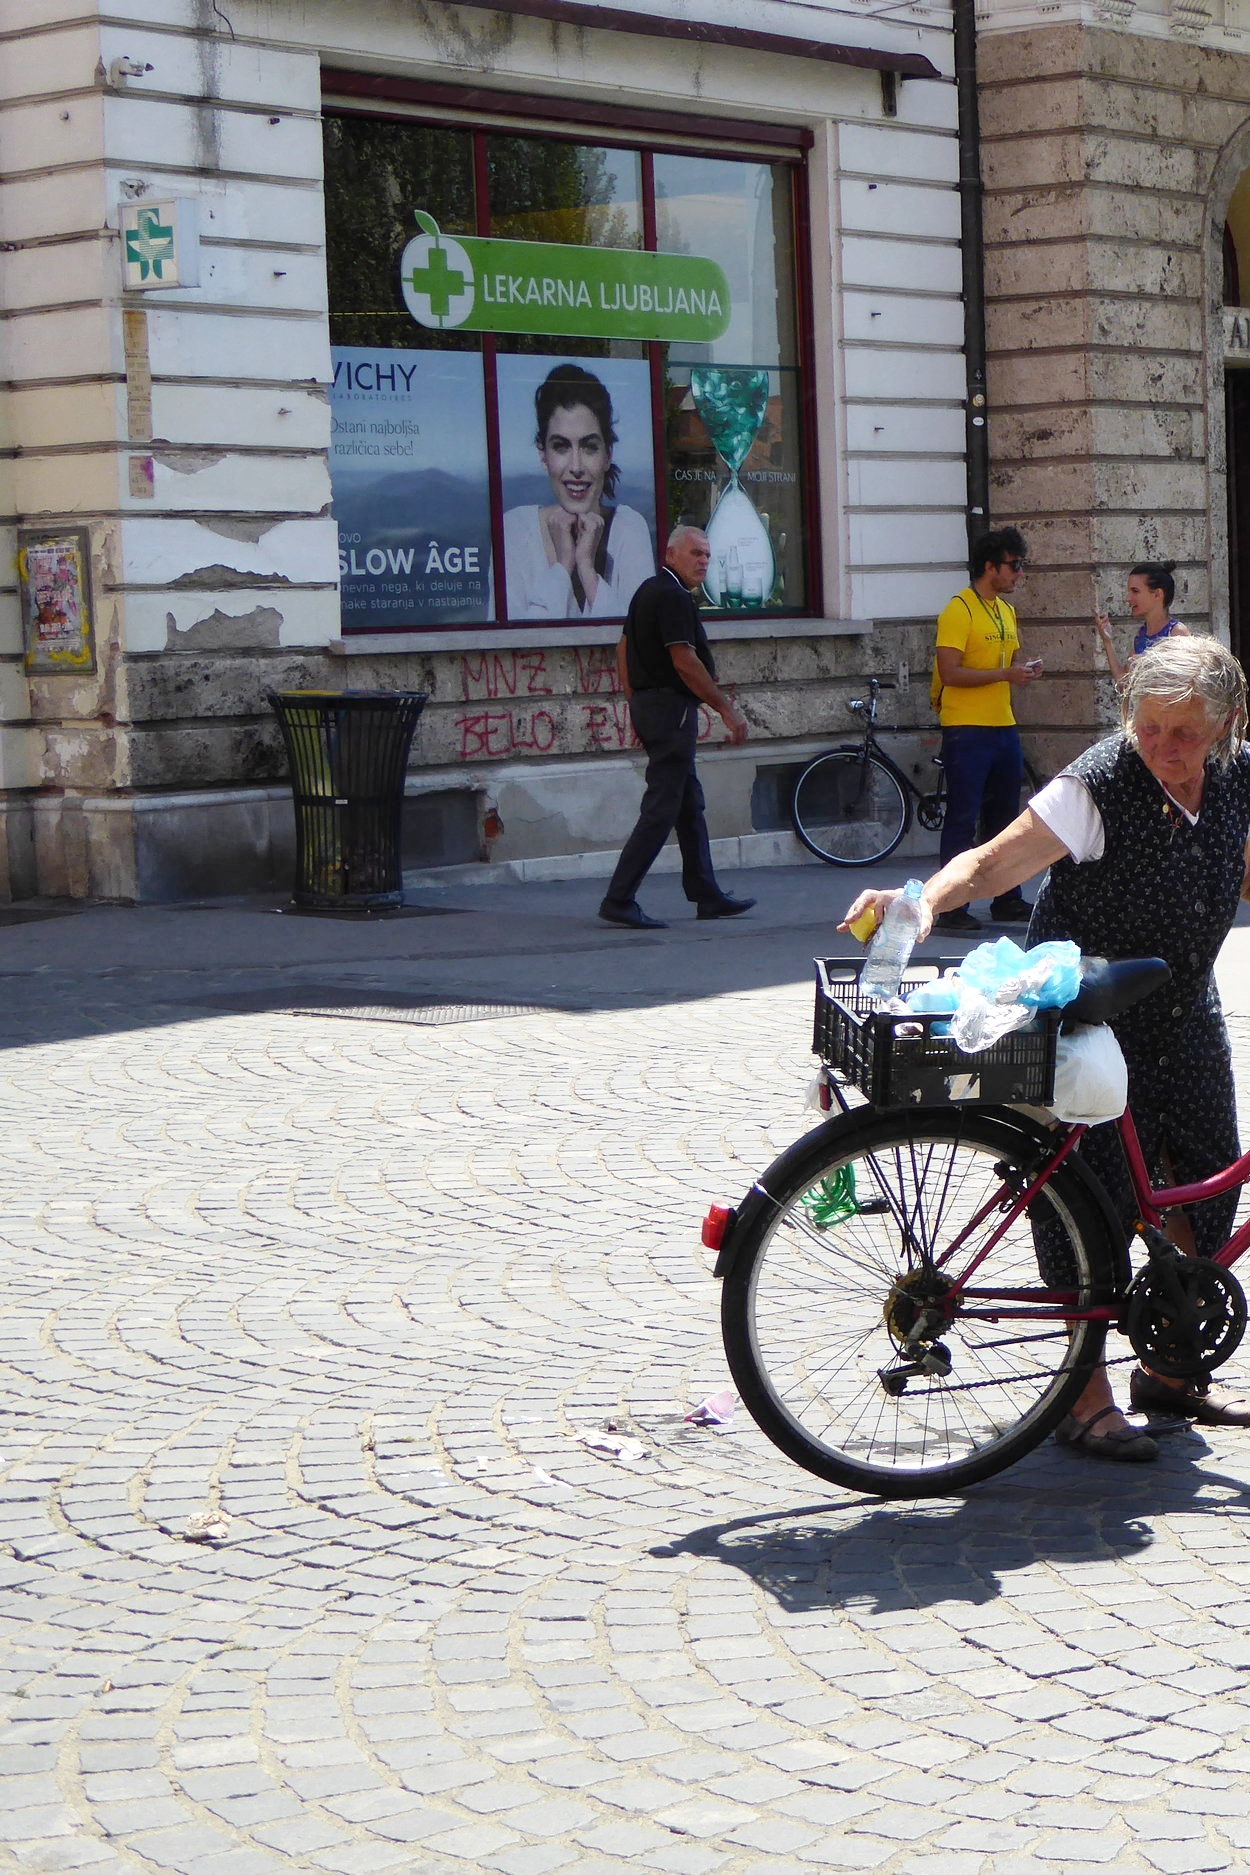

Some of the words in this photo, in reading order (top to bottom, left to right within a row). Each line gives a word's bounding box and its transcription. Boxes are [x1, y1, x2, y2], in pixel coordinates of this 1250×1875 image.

[483, 274, 592, 309] LEKARNA
[600, 282, 722, 317] LJUBLJANA
[370, 419, 420, 436] najboljša
[383, 440, 414, 456] sebe!
[339, 532, 361, 543] OVO
[338, 548, 415, 576] SLOW
[425, 540, 480, 574] ÂGE
[341, 583, 376, 594] nevna
[415, 579, 425, 591] ki
[430, 579, 463, 593] deluje
[468, 580, 481, 590] na
[341, 597, 367, 610] nake
[370, 598, 415, 611] staranja
